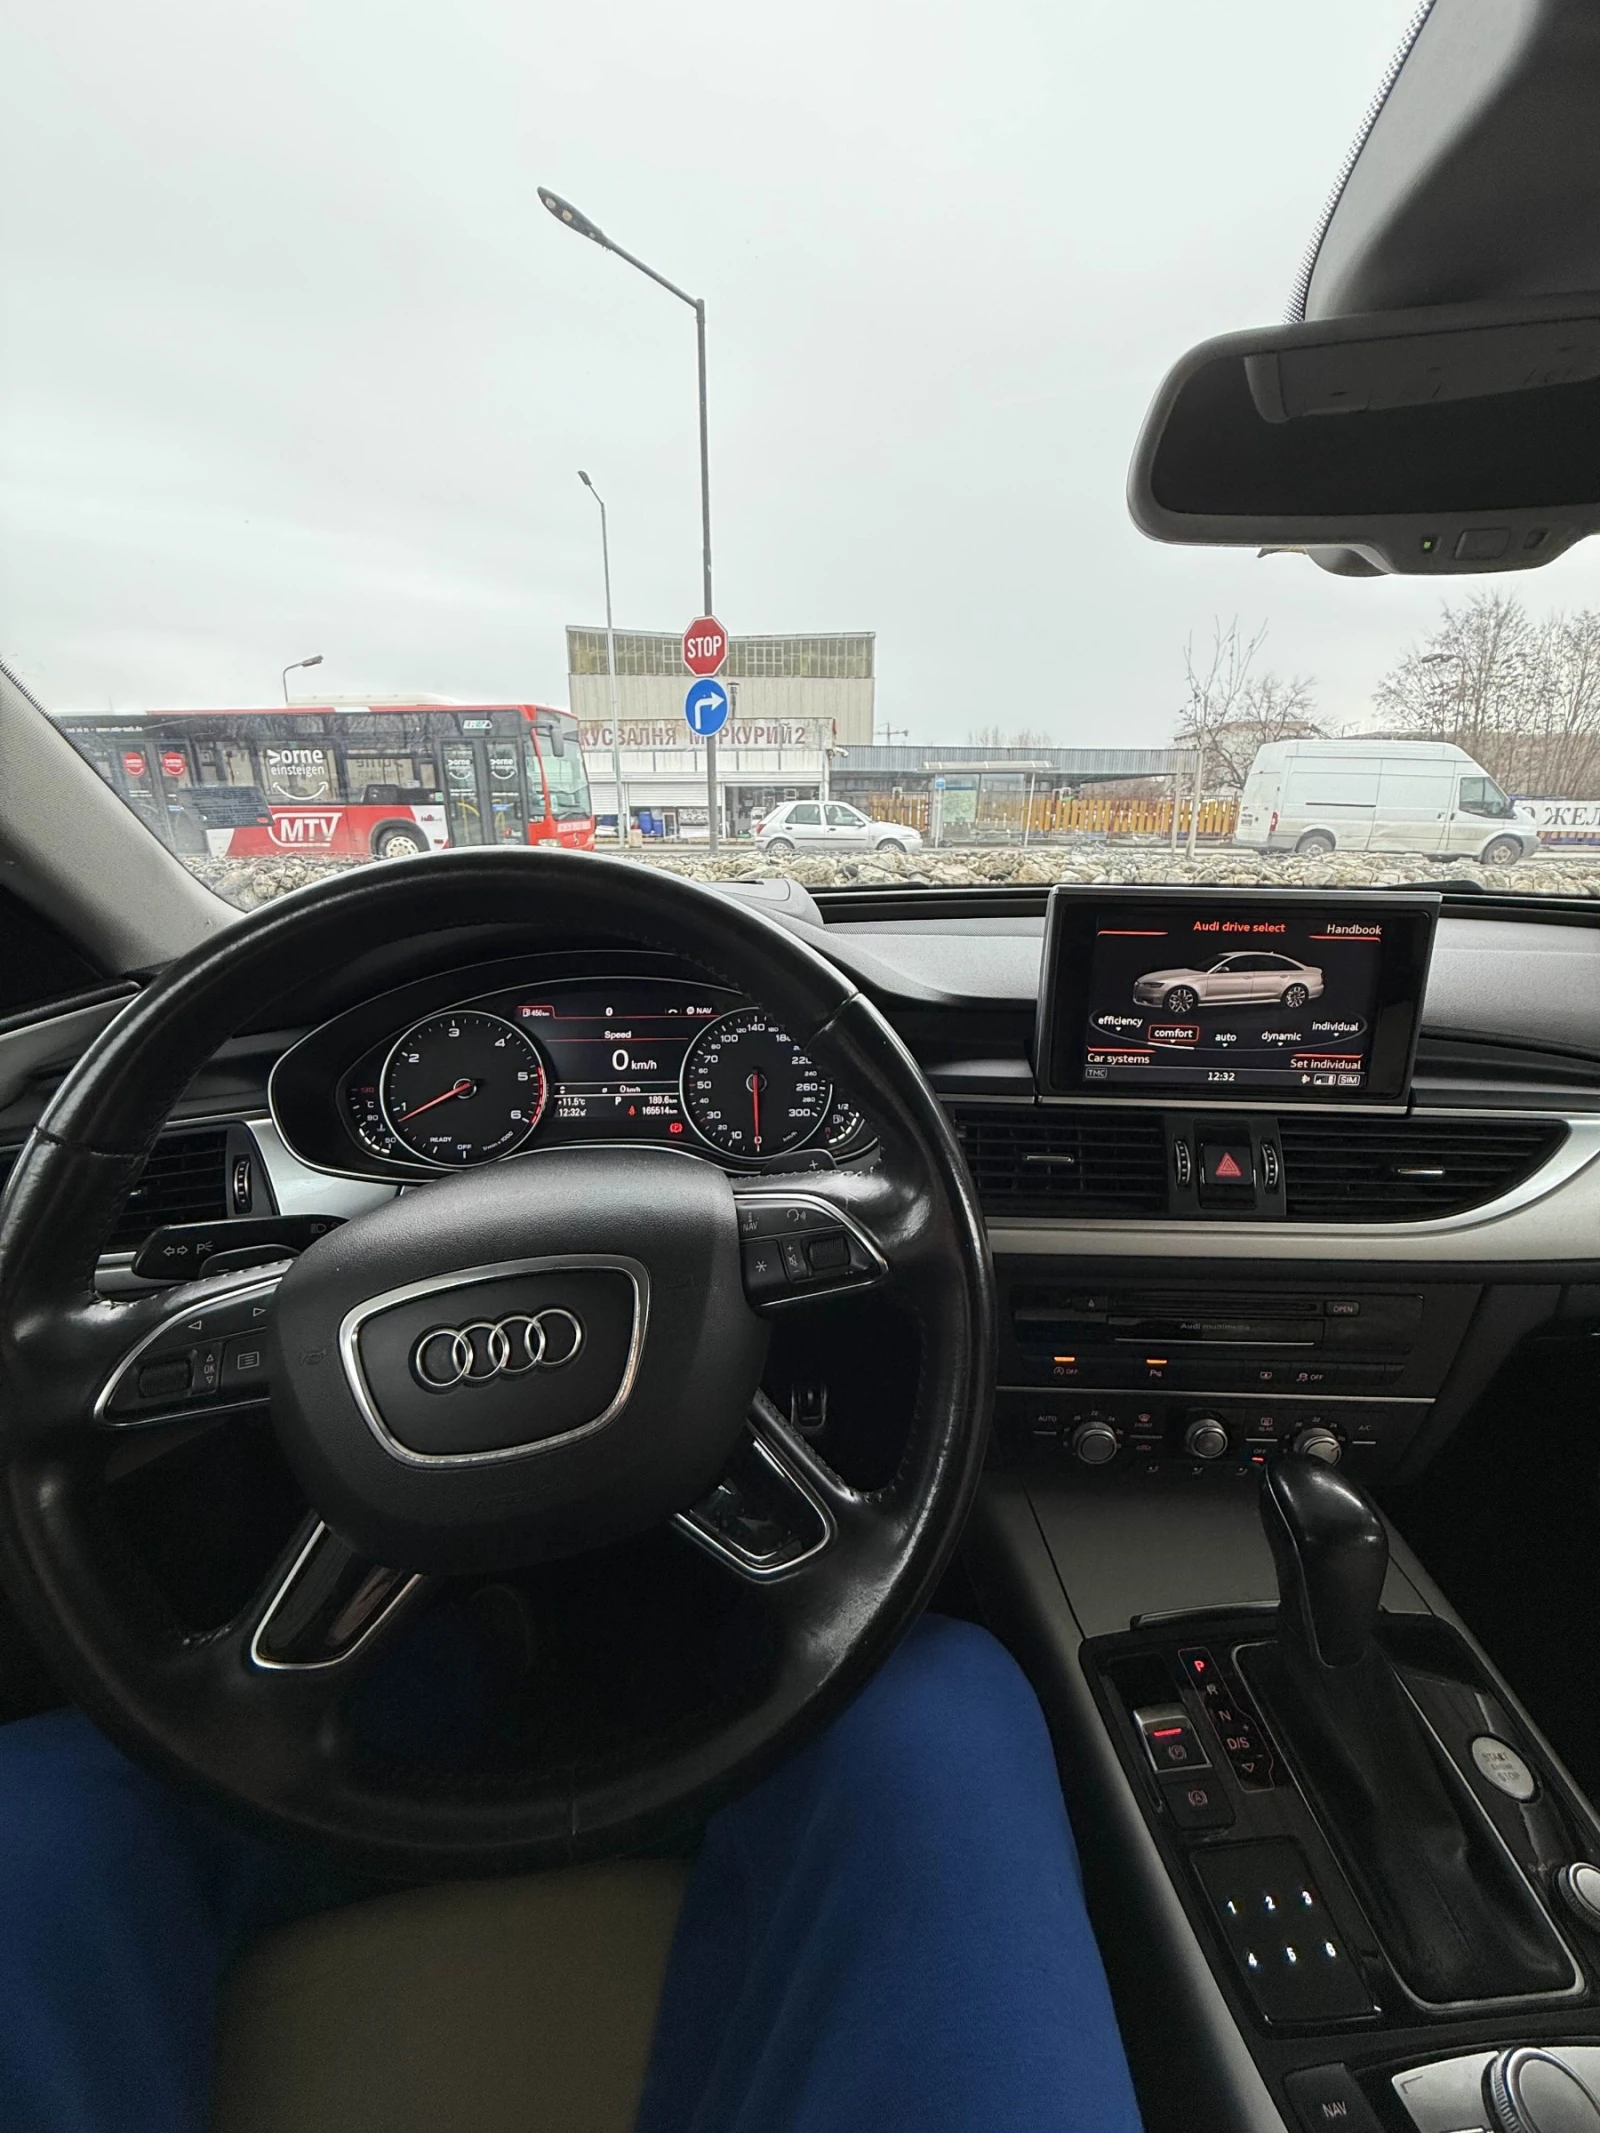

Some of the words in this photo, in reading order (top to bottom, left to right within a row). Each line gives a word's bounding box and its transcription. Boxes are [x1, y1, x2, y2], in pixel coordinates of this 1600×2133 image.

[687, 636, 721, 659] STOP
[270, 764, 325, 777] einsteigen
[281, 813, 342, 841] MTV
[1193, 921, 1220, 931] Audi
[1222, 922, 1250, 931] drive
[1253, 923, 1286, 932] select
[1327, 924, 1382, 934] Handbook
[1098, 1015, 1143, 1027] efficiency
[747, 1023, 765, 1031] 140
[1312, 1022, 1359, 1031] individual
[448, 1028, 460, 1037] 3
[604, 1030, 631, 1039] Speed
[1154, 1028, 1193, 1038] comfort
[1215, 1033, 1237, 1041] auto
[1261, 1031, 1302, 1042] dynamic
[494, 1038, 506, 1047] 4
[720, 1034, 739, 1043] 100
[408, 1053, 419, 1063] 2
[612, 1050, 628, 1070] 0
[631, 1059, 657, 1071] km/h
[703, 1055, 719, 1063] 70
[1087, 1053, 1105, 1063] Car
[1107, 1054, 1150, 1065] systems
[1290, 1059, 1308, 1068] Set
[1310, 1060, 1361, 1069] individual
[518, 1072, 528, 1081] 5
[1208, 1072, 1235, 1081] 12:32
[697, 1081, 712, 1089] 50
[796, 1083, 818, 1091] 260
[615, 1097, 621, 1105] P
[400, 1102, 407, 1111] 1
[838, 1103, 849, 1111] 1/2
[511, 1110, 521, 1120] 6
[559, 1108, 580, 1117] 12:32
[707, 1111, 721, 1119] 30
[788, 1109, 810, 1117] 300
[731, 1131, 742, 1139] 10
[743, 1222, 758, 1231] NAV
[1333, 1305, 1353, 1313] OPEN
[203, 1364, 215, 1374] OK
[1194, 1660, 1204, 1671] P
[1206, 1683, 1218, 1695] R
[1219, 1710, 1231, 1720] N
[1227, 1737, 1250, 1750] D/S
[1265, 1896, 1275, 1910] 2
[1302, 1891, 1312, 1905] 3
[1228, 1900, 1236, 1914] 1
[1286, 1947, 1296, 1962] 5
[1325, 1942, 1336, 1957] 6
[1248, 1953, 1257, 1967] 4
[1322, 2102, 1347, 2118] NAV
